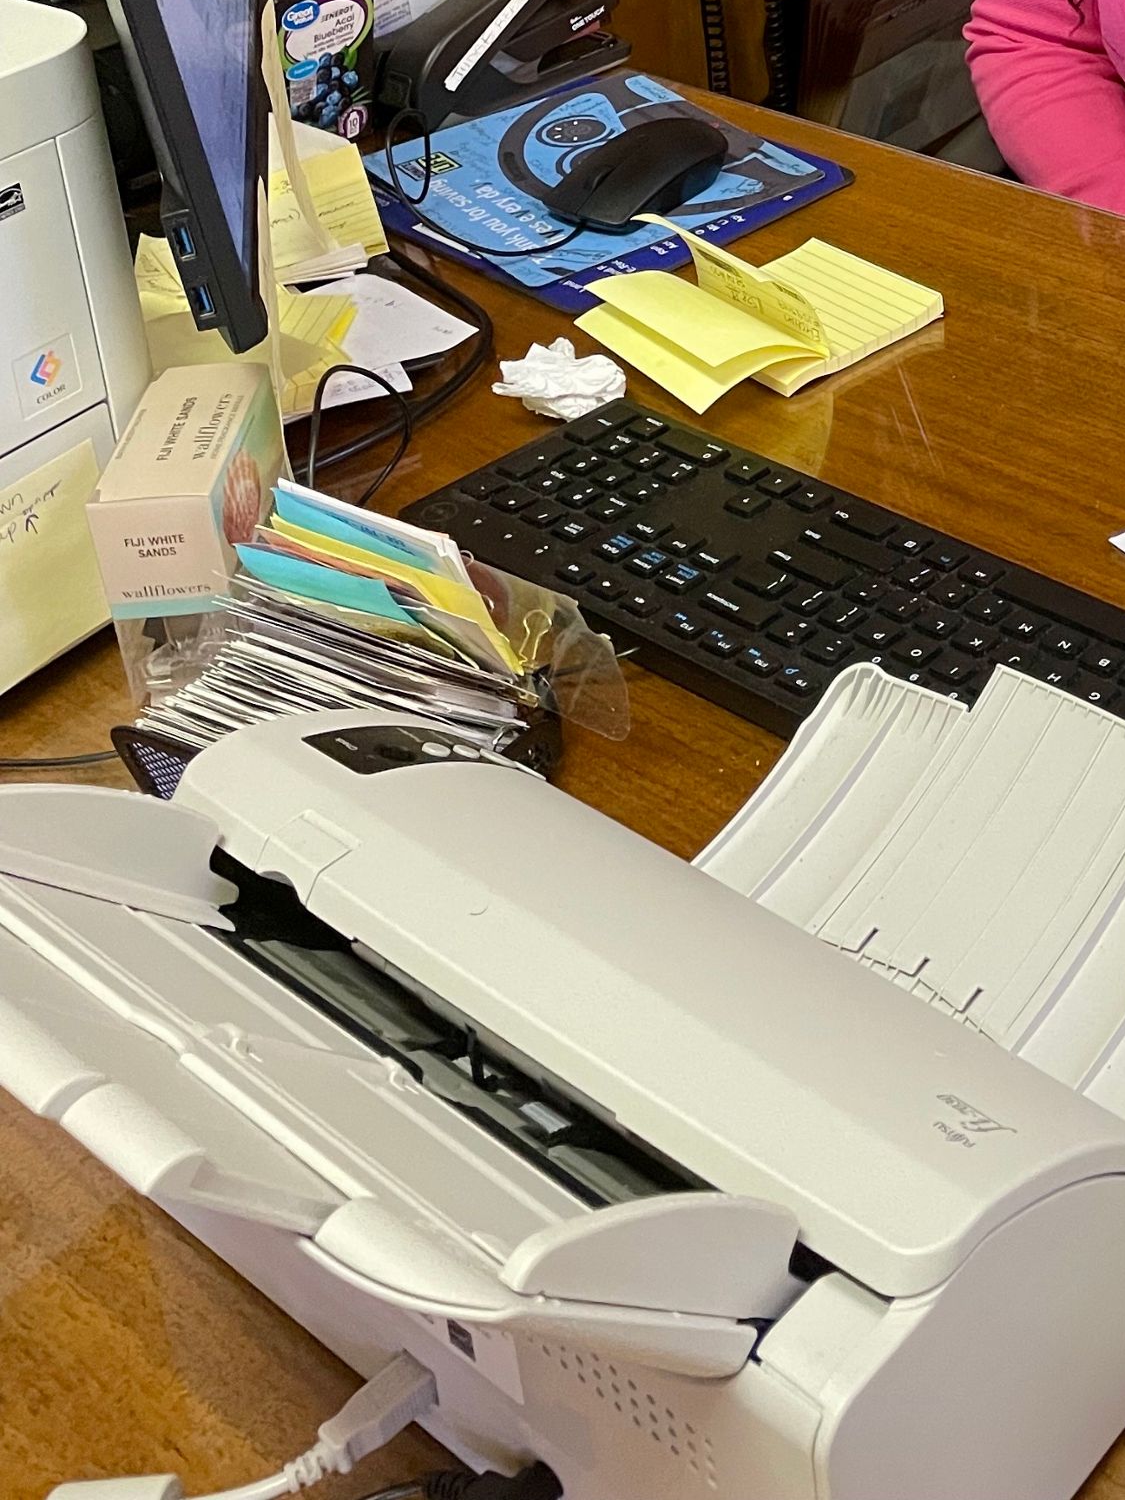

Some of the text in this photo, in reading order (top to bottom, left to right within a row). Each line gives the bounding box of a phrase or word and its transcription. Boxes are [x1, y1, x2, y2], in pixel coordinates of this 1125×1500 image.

[571, 18, 586, 32] ONE
[313, 23, 355, 44] Blueberry
[36, 383, 67, 405] COLOR
[165, 422, 186, 448] WHITE
[176, 396, 199, 423] SANDS
[192, 393, 233, 461] wallflowers
[124, 534, 185, 548] FIJI WHITE
[138, 546, 177, 558] SANDS
[122, 583, 212, 600] wallflowers
[1058, 641, 1071, 649] N
[1045, 673, 1061, 685] H
